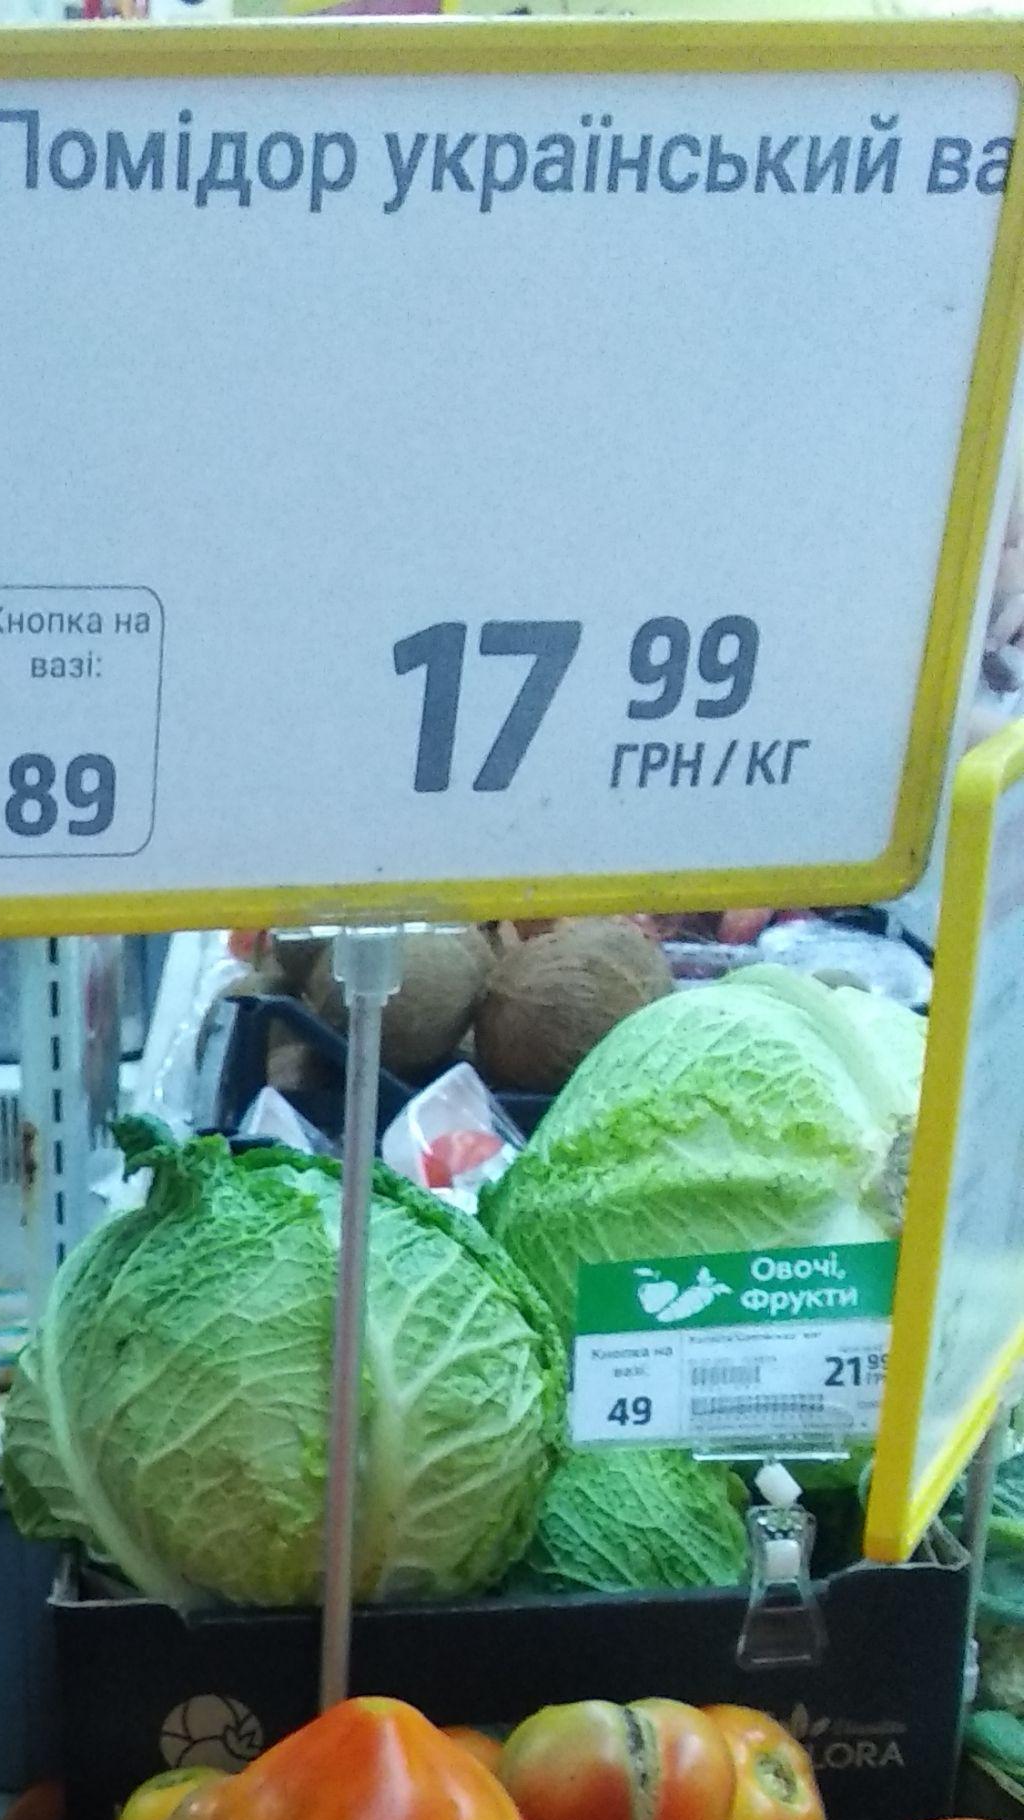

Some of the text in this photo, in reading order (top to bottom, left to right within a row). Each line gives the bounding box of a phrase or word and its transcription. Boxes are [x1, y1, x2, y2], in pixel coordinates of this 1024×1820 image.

[383, 113, 902, 215] український
[114, 611, 151, 635] на
[30, 650, 103, 679] вазі:
[393, 614, 760, 793] 17 99
[4, 752, 117, 837] 89
[749, 1250, 847, 1281] Овочі,
[823, 1355, 862, 1387] 21
[607, 1395, 653, 1427] 49
